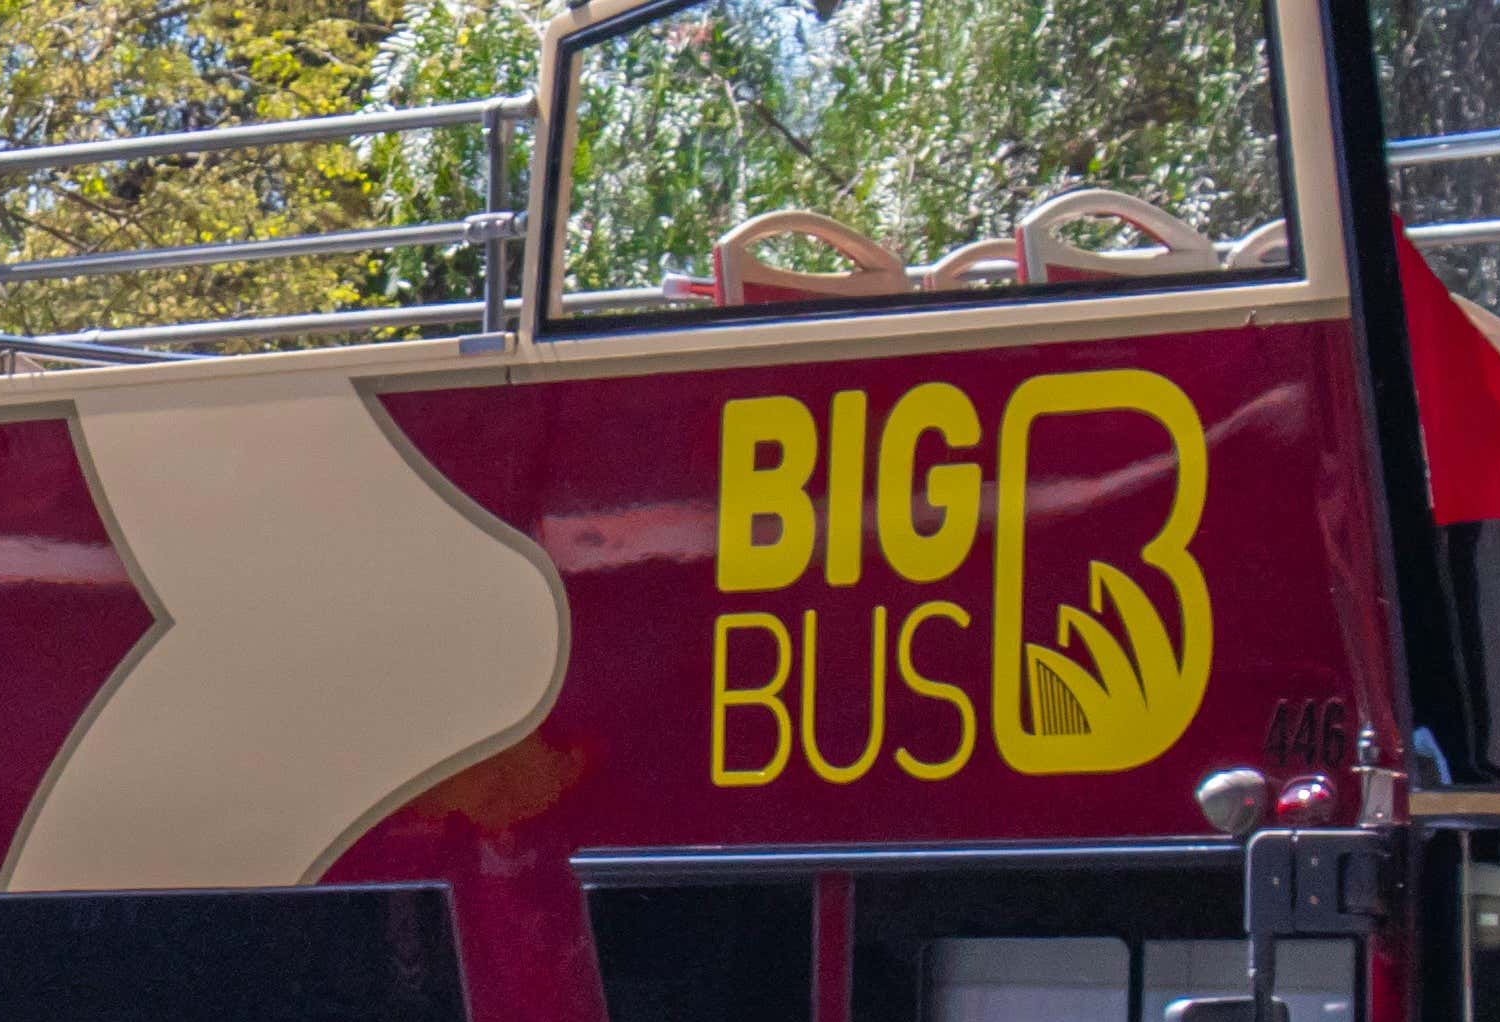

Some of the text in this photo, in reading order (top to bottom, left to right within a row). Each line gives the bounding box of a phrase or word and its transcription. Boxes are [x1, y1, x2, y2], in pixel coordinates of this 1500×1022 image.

[716, 381, 982, 591] BIG
[710, 600, 977, 787] BUS
[1263, 697, 1346, 767] 446
